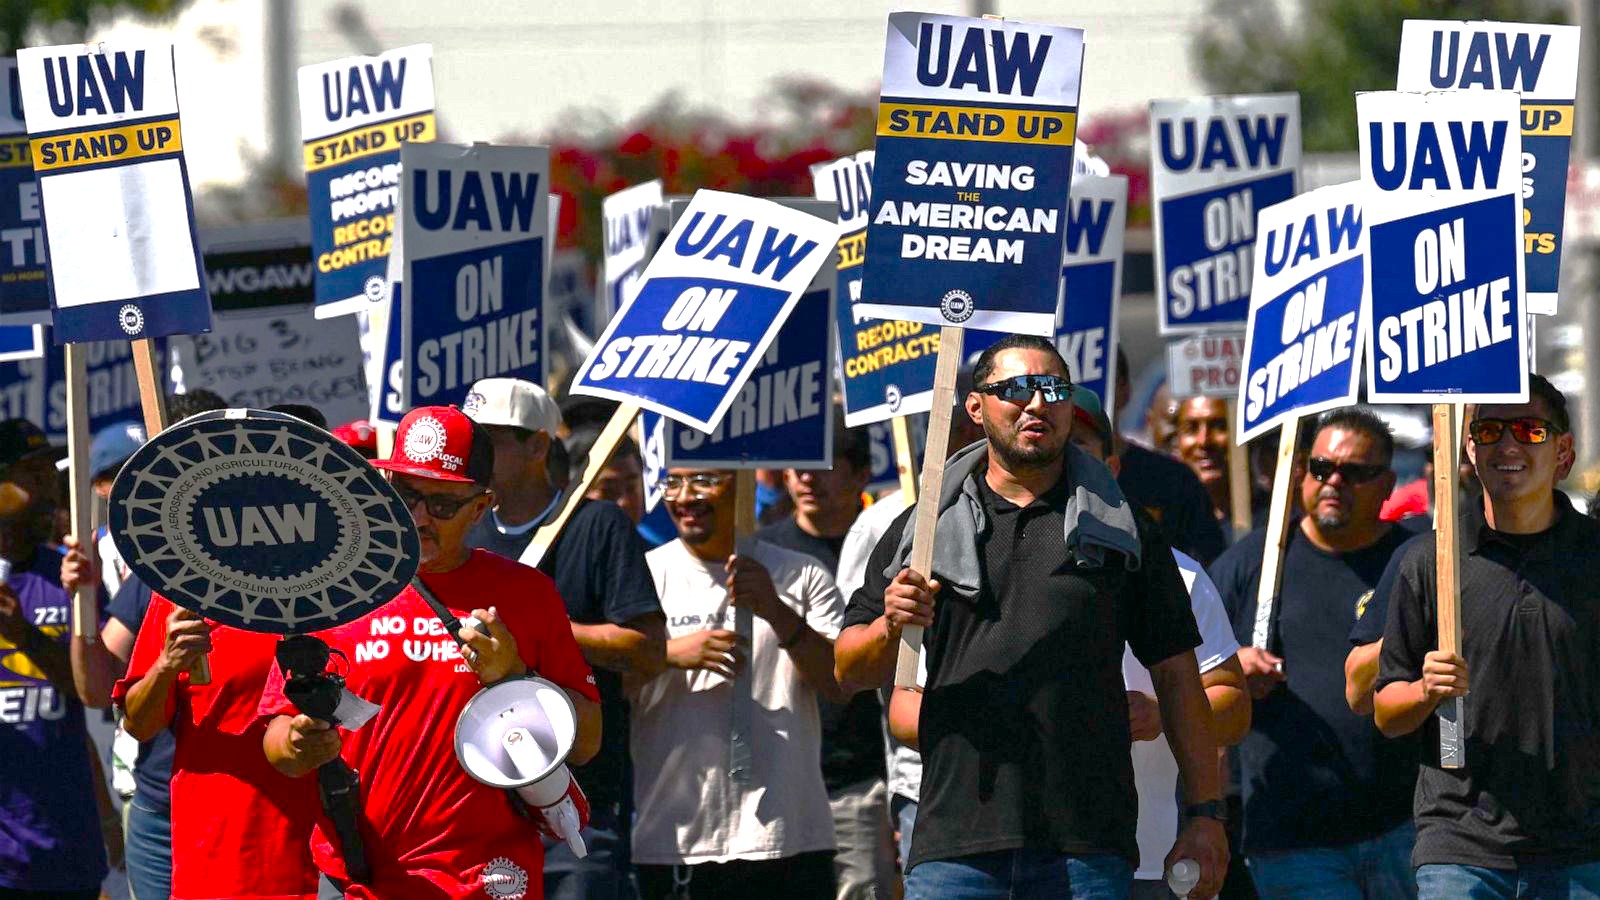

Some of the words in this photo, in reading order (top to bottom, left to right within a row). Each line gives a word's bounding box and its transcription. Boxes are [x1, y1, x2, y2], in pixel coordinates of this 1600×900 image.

[917, 22, 1053, 97] UAW
[1430, 30, 1552, 92] UAW
[43, 49, 145, 118] UAW
[322, 57, 407, 122] UAW
[313, 130, 386, 164] STAND
[394, 121, 426, 142] UP
[889, 109, 1005, 136] STAND
[1017, 115, 1063, 139] UP
[1521, 110, 1562, 131] UP
[40, 134, 128, 165] STAND
[136, 127, 171, 151] UP
[1160, 114, 1288, 174] UAW
[1369, 120, 1508, 191] UAW
[905, 160, 1035, 191] SAVING
[957, 191, 980, 202] THE
[413, 169, 540, 232] UAW
[874, 200, 1058, 234] AMERICAN
[1204, 187, 1254, 251] ON
[675, 211, 819, 282] UAW
[901, 234, 1025, 265] DREAM
[1265, 204, 1362, 277] UAW
[1414, 218, 1466, 295] ON
[456, 256, 503, 323] ON
[1168, 243, 1254, 320] STRI
[662, 286, 739, 332] ON
[1281, 275, 1328, 345] ON
[1379, 276, 1512, 382] STRIKE
[417, 309, 538, 398] STRIKE
[846, 333, 941, 378] CONTRACTS
[857, 319, 923, 351] RECORD
[1203, 336, 1246, 358] UA
[589, 334, 751, 386] STRIKE
[1192, 366, 1240, 386] PRO
[1246, 311, 1356, 422] STRIKE
[191, 466, 214, 483] AND
[214, 459, 306, 477] AGRICULTURAL
[439, 453, 463, 466] LOCAL
[442, 462, 457, 471] 230
[168, 480, 194, 531] AEROSPACE
[307, 472, 358, 519] IMPLEMENT
[203, 503, 317, 547] UAW
[342, 518, 362, 563] WORKERS
[283, 570, 335, 594] AMERICA
[34, 606, 68, 626] 721
[371, 616, 406, 636] NO
[670, 614, 702, 627] LOS
[355, 640, 389, 663] NO
